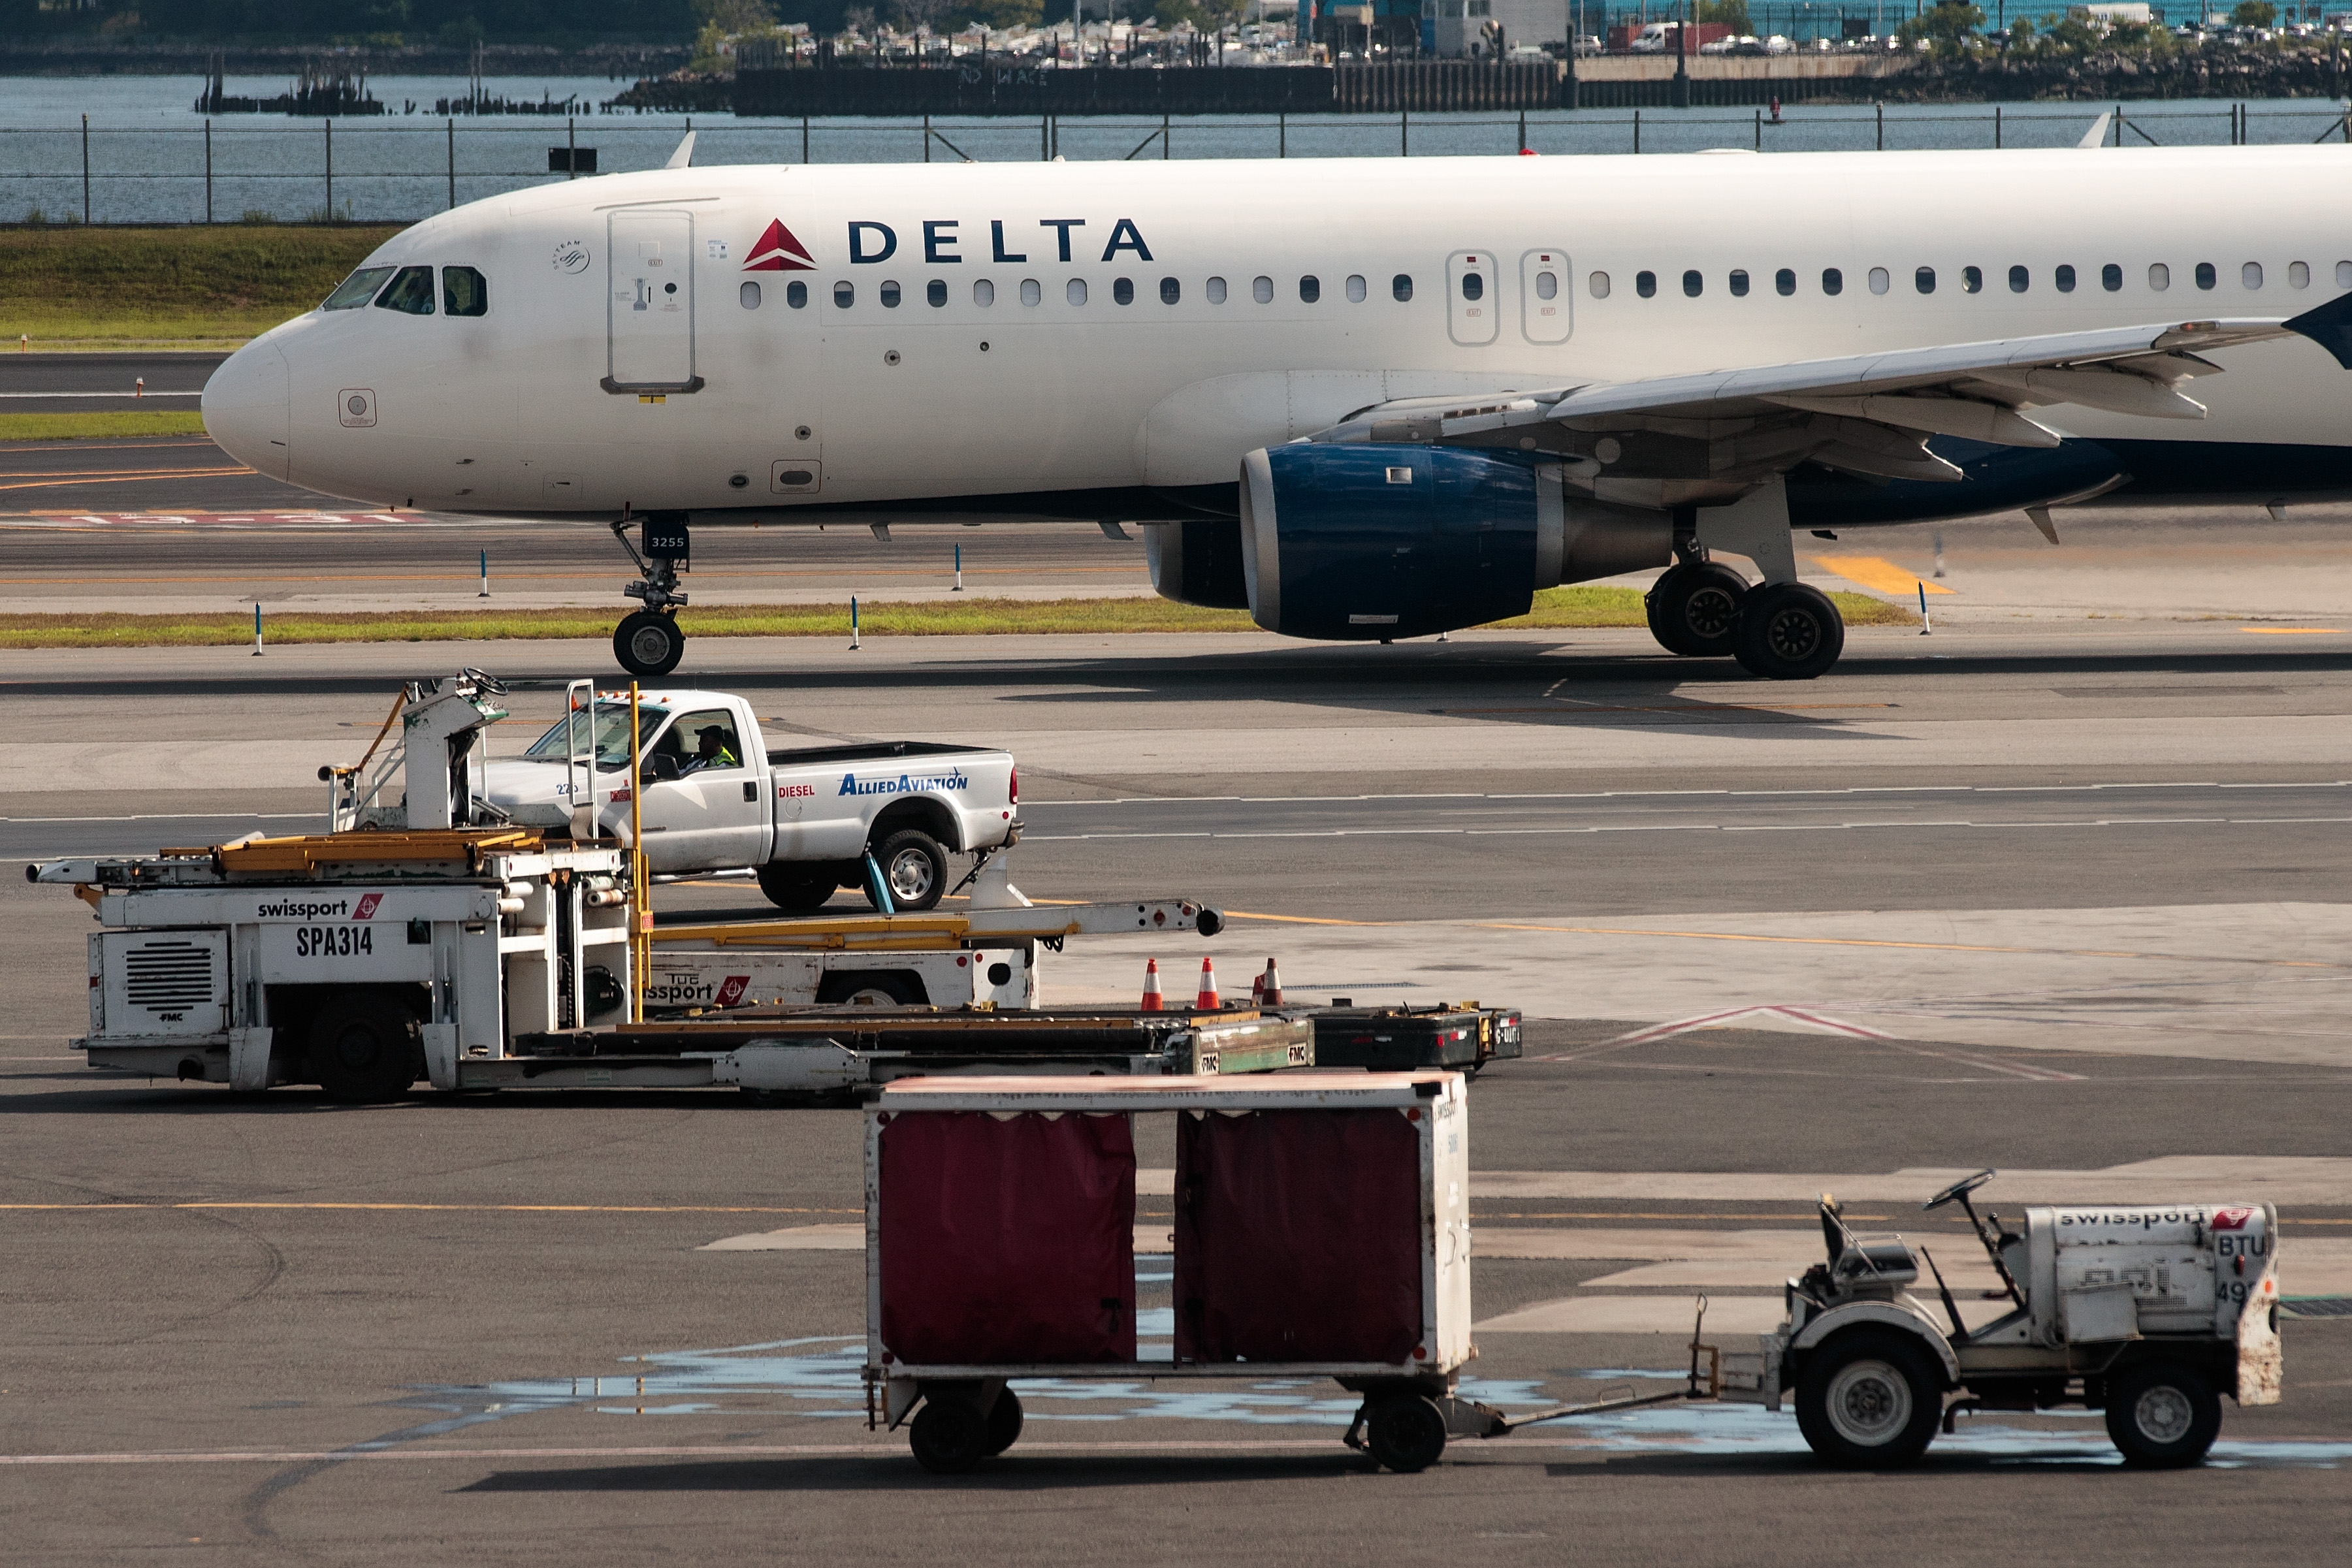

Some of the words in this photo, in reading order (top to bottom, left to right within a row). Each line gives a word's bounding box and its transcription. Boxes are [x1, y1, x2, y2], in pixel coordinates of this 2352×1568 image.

[848, 218, 1154, 264] DELTA
[552, 240, 580, 270] SKYTEAM
[652, 537, 685, 547] 3255
[779, 785, 814, 798] DIESEL
[258, 898, 347, 921] swissport
[297, 926, 372, 957] SPA314
[159, 1013, 183, 1022] FMC
[1201, 1055, 1217, 1072] FMC
[1289, 1046, 1305, 1062] FMC
[2219, 1235, 2265, 1256] BTU
